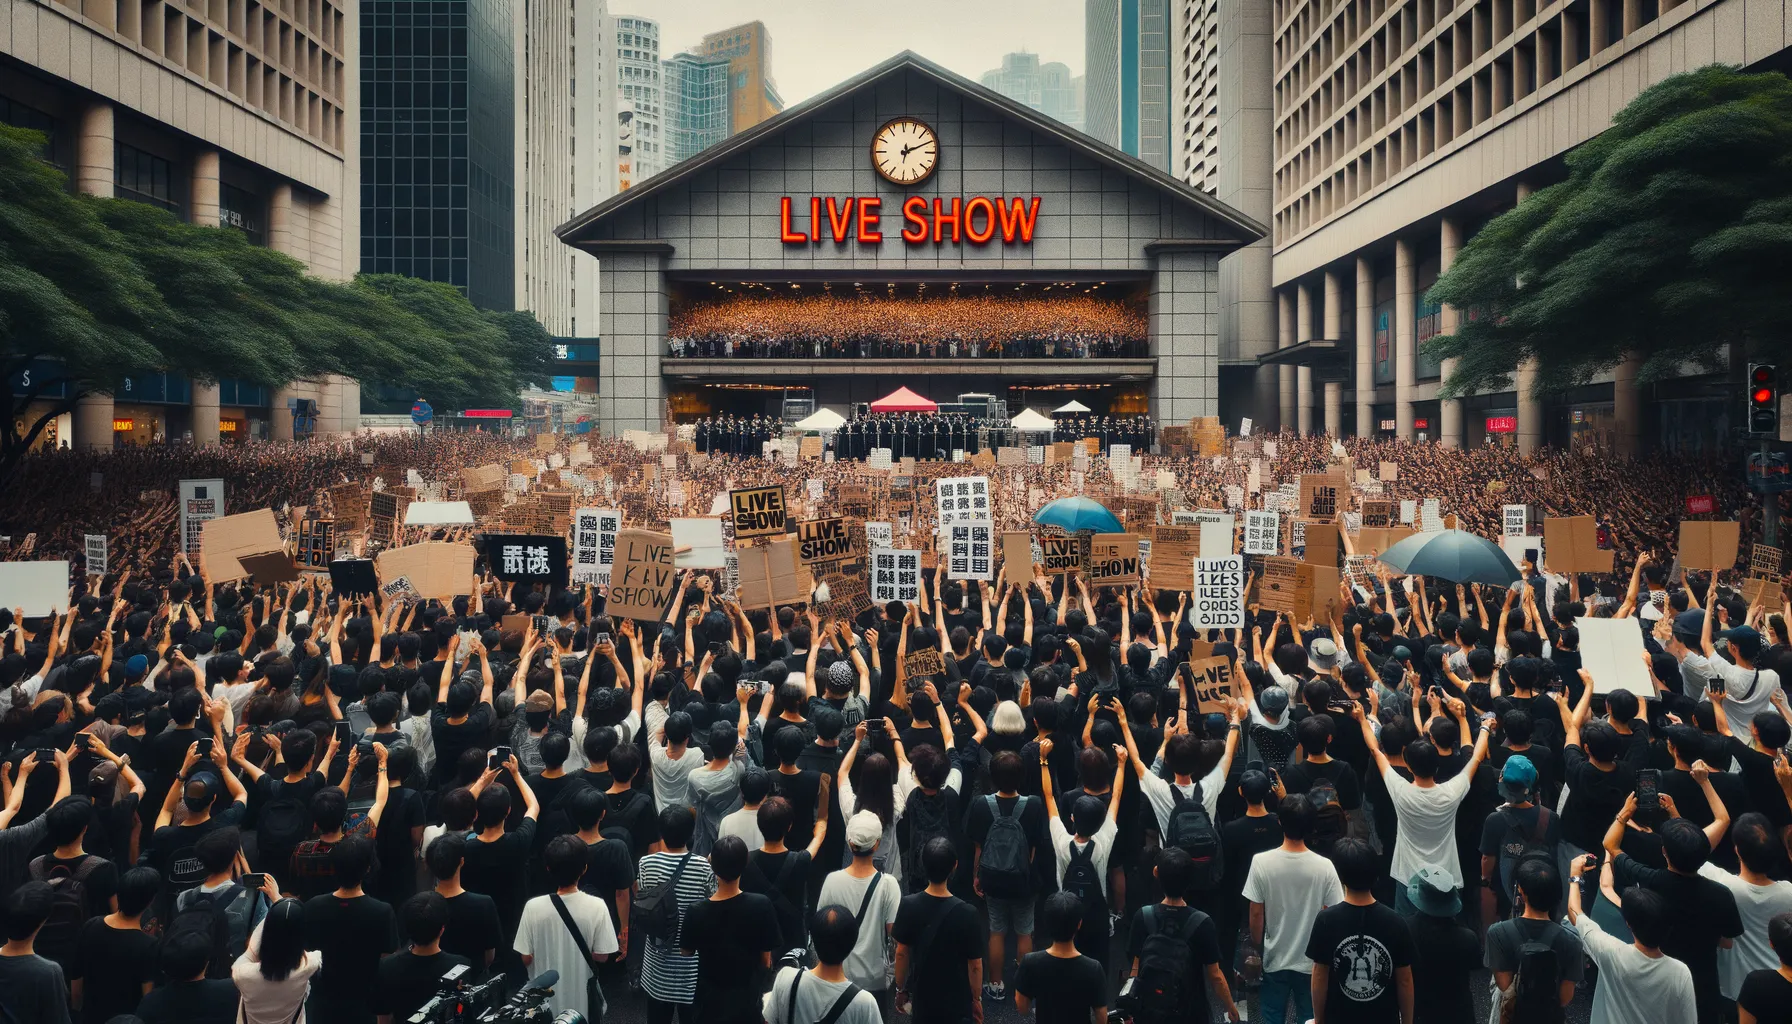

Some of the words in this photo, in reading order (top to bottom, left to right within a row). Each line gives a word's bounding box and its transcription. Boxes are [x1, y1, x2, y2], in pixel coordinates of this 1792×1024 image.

[781, 197, 882, 243] LIVE
[902, 196, 1042, 244] SHOW
[736, 492, 780, 513] LIVE
[628, 541, 672, 564] LIVE
[801, 537, 850, 559] SHOW
[611, 586, 673, 608] SHOW
